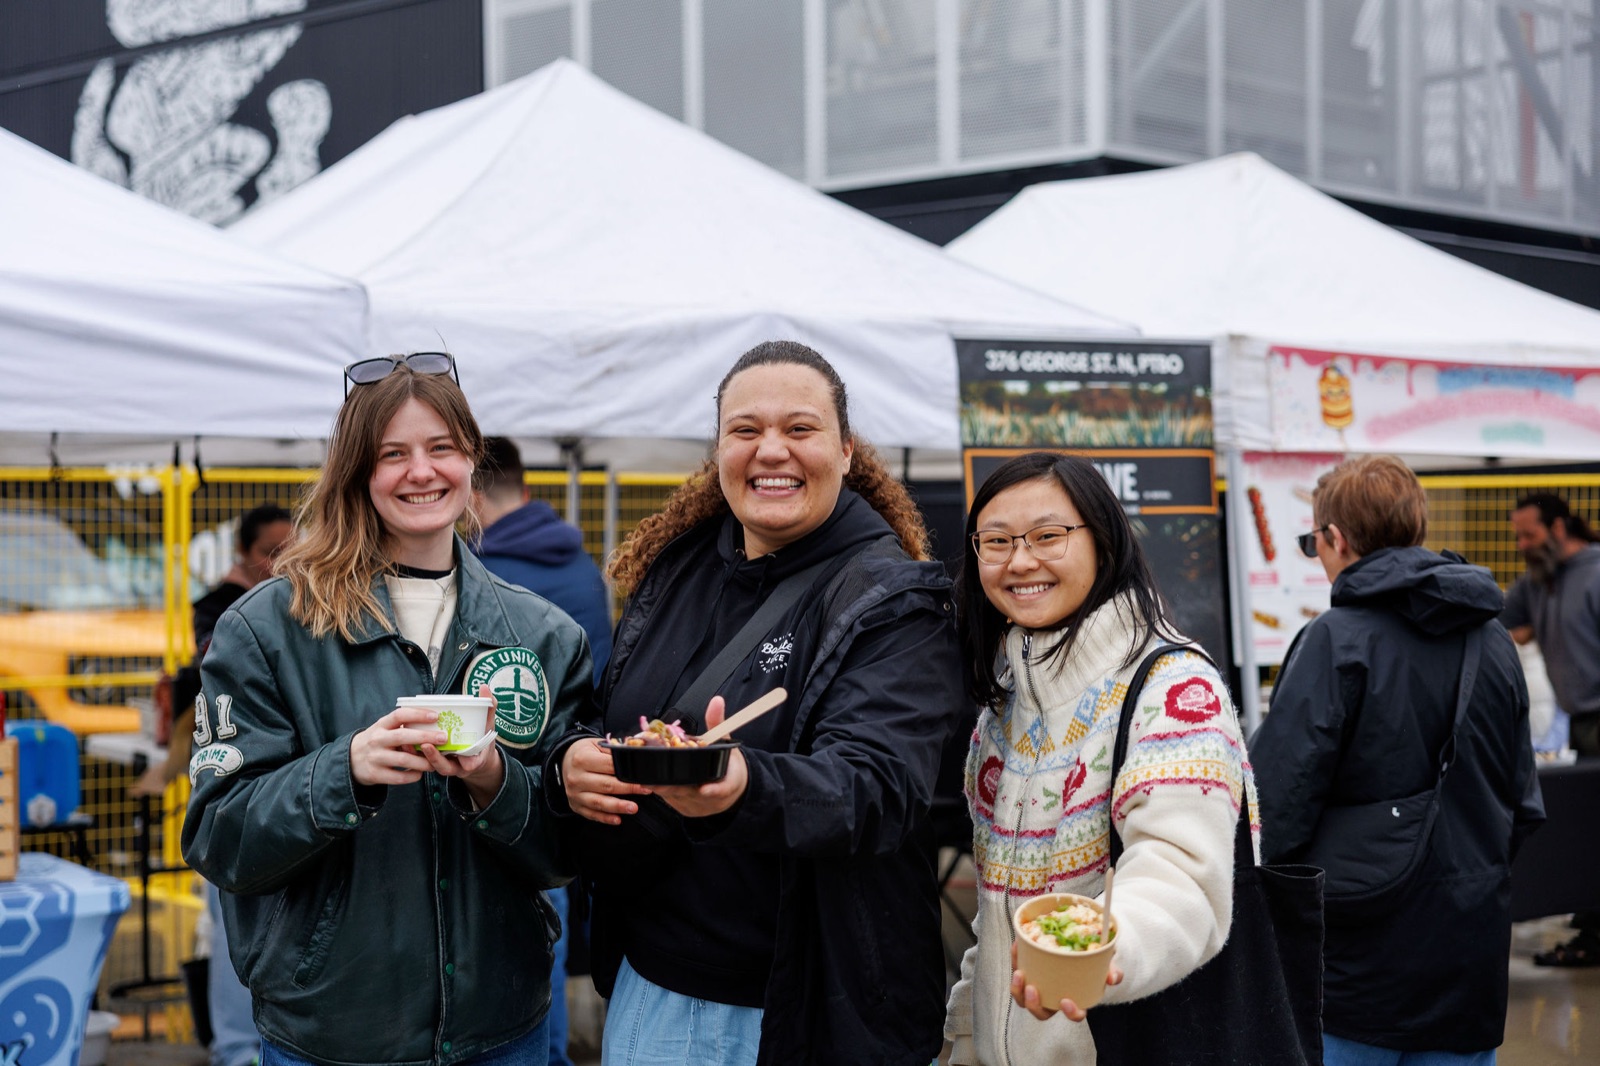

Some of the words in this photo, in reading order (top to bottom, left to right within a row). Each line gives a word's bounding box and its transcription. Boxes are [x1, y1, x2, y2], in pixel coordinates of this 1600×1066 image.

[1020, 350, 1089, 373] GEORGE
[471, 656, 498, 698] TRENT
[196, 748, 228, 766] PRIME
